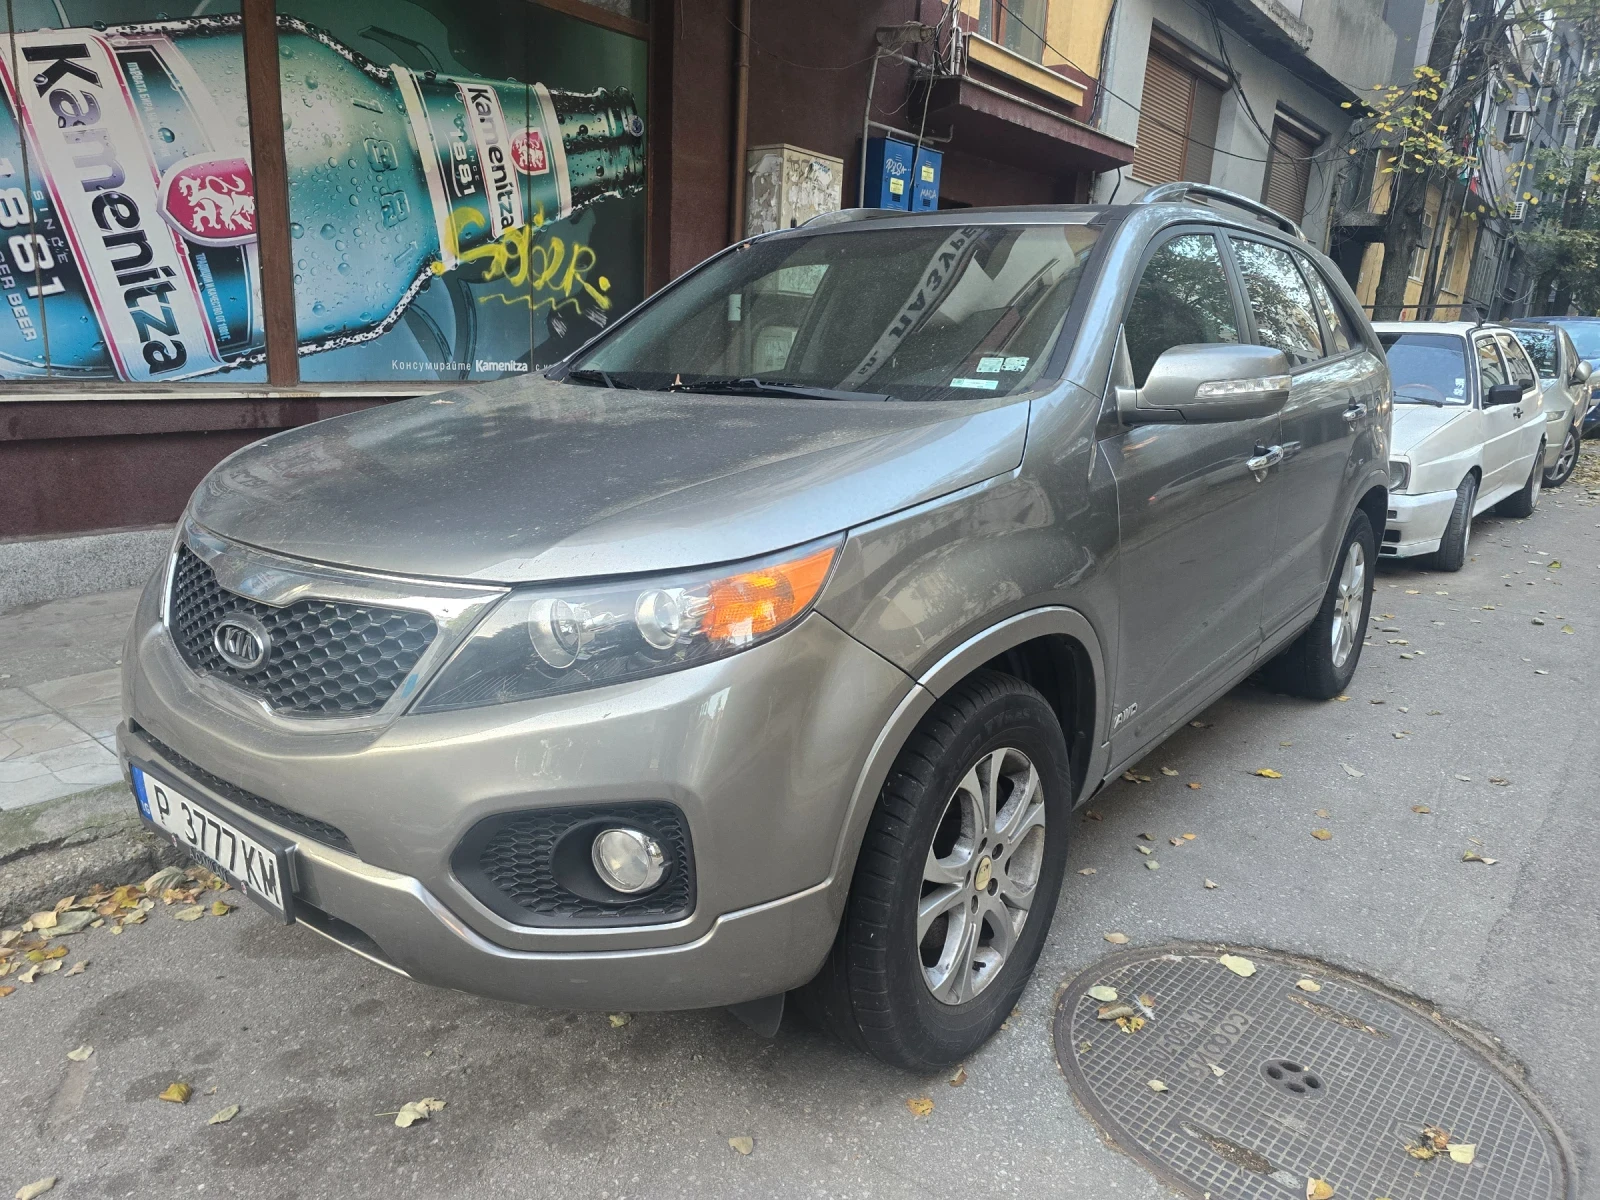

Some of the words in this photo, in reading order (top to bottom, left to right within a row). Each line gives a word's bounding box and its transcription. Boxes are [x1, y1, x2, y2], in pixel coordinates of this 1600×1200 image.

[450, 128, 477, 197] 1881
[467, 86, 515, 229] Kamenitza
[22, 43, 188, 375] Kamenitza
[33, 190, 69, 264] SINCE
[7, 292, 38, 342] BEER
[391, 359, 471, 372] Консумирайте
[475, 359, 528, 372] Kamenitza
[1114, 702, 1138, 729] AWD
[154, 785, 170, 825] P
[181, 802, 236, 873] 3777
[1181, 1013, 1249, 1079] СОФИЯ
